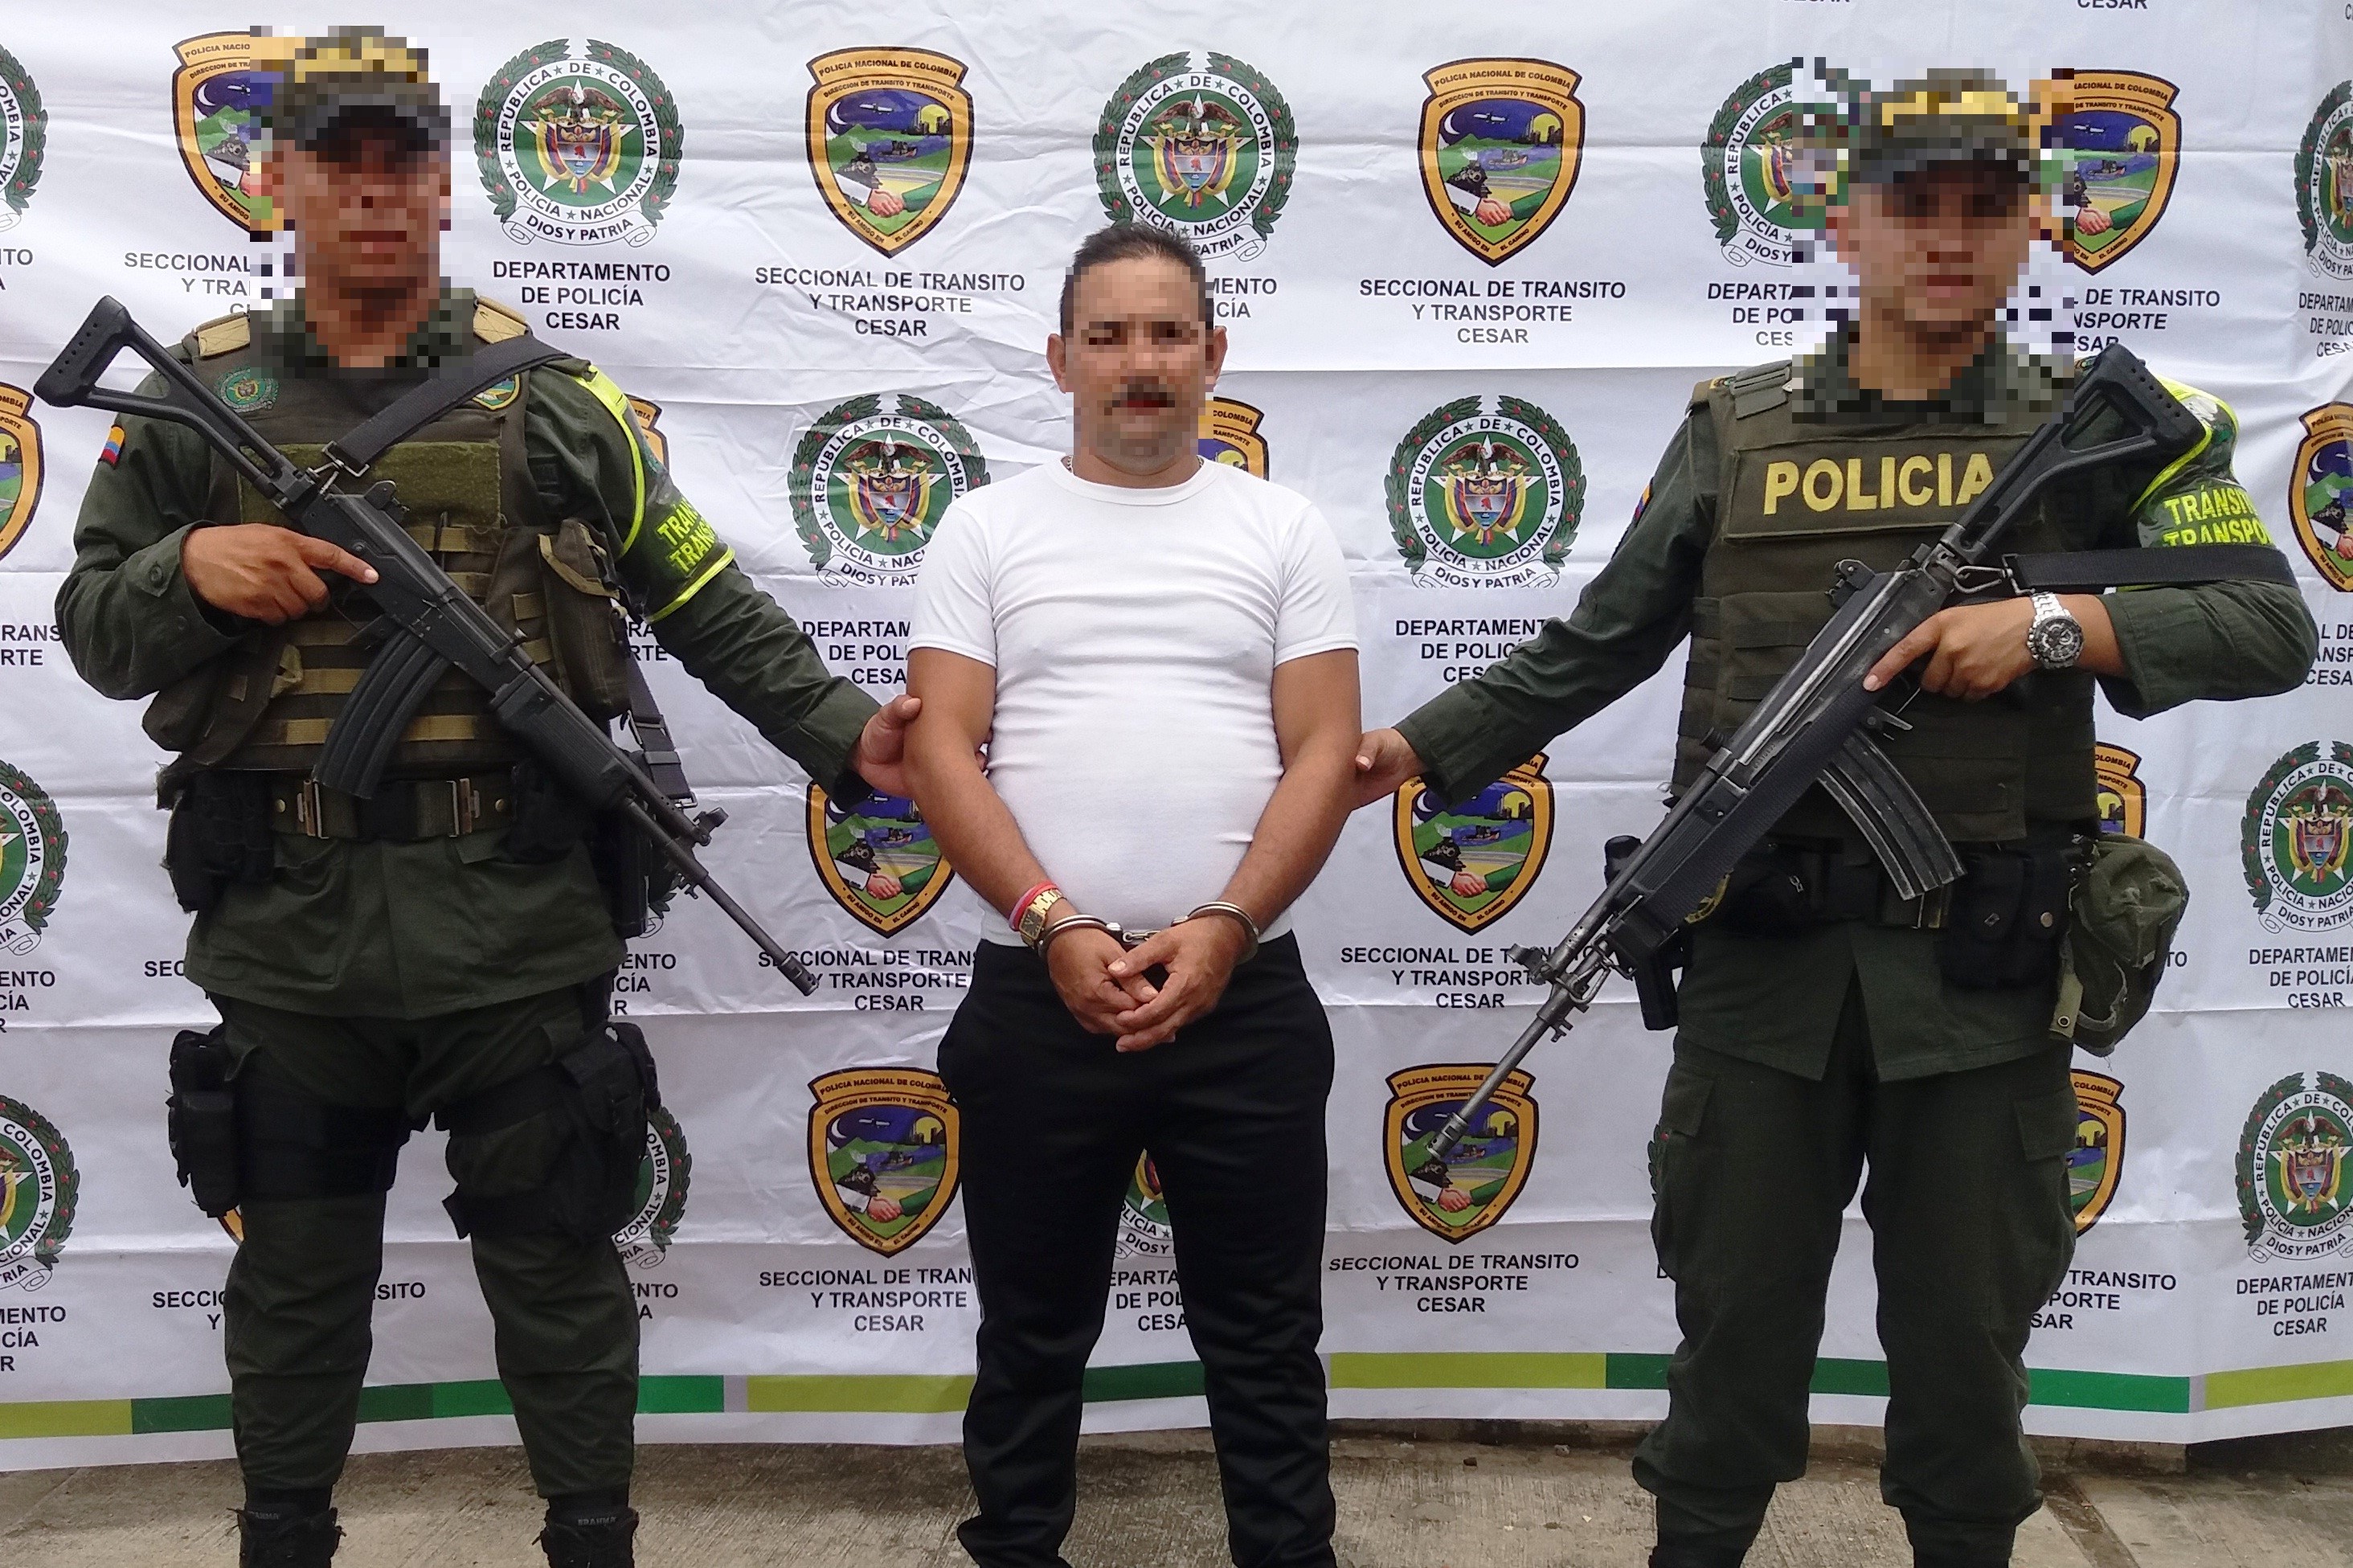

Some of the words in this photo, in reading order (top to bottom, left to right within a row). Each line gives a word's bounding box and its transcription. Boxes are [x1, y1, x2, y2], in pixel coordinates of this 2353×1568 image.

[185, 44, 221, 59] POLICIA
[819, 61, 853, 77] POLICIA
[855, 59, 898, 68] NACIONAL
[915, 61, 957, 80] COLOMBIA
[1434, 72, 1468, 87] POLICIA
[1470, 71, 1512, 79] NACIONAL
[1528, 72, 1570, 89] COLOMBIA
[2127, 84, 2168, 101] COLOMBIA
[570, 63, 591, 74] DE
[609, 73, 657, 157] COLOMBIA
[1191, 76, 1211, 87] DE
[1229, 86, 1271, 167] COLOMBIA
[581, 175, 651, 220] NACIONAL
[1194, 187, 1264, 235] NACIONAL
[581, 219, 633, 240] PATRIA
[494, 261, 669, 281] DEPARTAMENTO
[755, 268, 878, 287] SECCIONAL
[886, 272, 912, 288] DE
[919, 273, 1024, 291] TRANSITO
[182, 278, 195, 292] Y
[1361, 280, 1480, 297] SECCIONAL
[1488, 281, 1514, 297] DE
[1522, 281, 1625, 298] TRANSITO
[1708, 283, 1792, 300] DEPART
[522, 287, 550, 303] DE
[558, 285, 643, 305] POLICÍA
[809, 293, 821, 309] Y
[829, 295, 971, 312] TRANSPORTE
[2085, 289, 2113, 305] DE
[2120, 289, 2220, 306] TRANSITO
[2299, 293, 2353, 313] DEPARTAM
[546, 313, 620, 330] CESAR
[1412, 305, 1425, 319] Y
[1431, 305, 1571, 321] TRANSPORTE
[1733, 308, 1759, 323] DE
[2074, 312, 2167, 330] NSPORTE
[856, 319, 927, 336] CESAR
[2310, 317, 2325, 334] DE
[2328, 318, 2353, 336] POLIC
[1458, 328, 1528, 343] CESAR
[881, 417, 901, 428] DE
[1480, 419, 1501, 430] DE
[1517, 428, 1561, 507] COLOMBIA
[1764, 452, 1995, 516] POLICIA
[2163, 484, 2259, 526] TRÁNSIT
[2163, 518, 2275, 547] TRANSPO
[1486, 525, 1553, 571] NACIONAL
[1486, 567, 1537, 588] PATRIA
[803, 621, 911, 637] DEPARTAM
[1396, 619, 1547, 637] DEPARTAMENT
[829, 645, 856, 660] DE
[1422, 644, 1448, 658] DE
[1456, 640, 1519, 660] POLIC
[852, 668, 906, 685] CESA
[2318, 763, 2335, 774] DE
[884, 950, 910, 964] DE
[917, 951, 976, 967] TRAN
[1341, 948, 1459, 963] SECCIONAL
[1467, 948, 1492, 963] DE
[2249, 947, 2353, 964] DEPARTAME
[829, 972, 967, 988] TRANSPORTE
[1392, 970, 1404, 985] Y
[1410, 970, 1548, 986] TRANSPORT
[2270, 972, 2291, 986] DE
[855, 995, 923, 1011] CESAR
[1436, 993, 1505, 1009] CESAR
[2288, 993, 2345, 1009] CESAR
[820, 1081, 852, 1095] POLICIA
[2304, 1093, 2320, 1104] DE
[5, 1124, 53, 1202] COLOMBIA
[2308, 1206, 2353, 1238] NACION
[2306, 1233, 2347, 1255] PATRIA
[1329, 1256, 1442, 1271] SECCIONAL
[1449, 1255, 1474, 1269] DE
[1481, 1255, 1578, 1269] TRANSITO
[759, 1270, 877, 1286] SECCIONAL
[884, 1269, 910, 1283] DE
[1377, 1276, 1389, 1290] Y
[1394, 1275, 1528, 1290] TRANSPORTE
[2069, 1270, 2175, 1290] TRANSITO
[2236, 1272, 2353, 1294] DEPARTAMENT
[153, 1291, 226, 1308] SECCIO
[811, 1292, 824, 1308] Y
[829, 1292, 966, 1308] TRANSPORTE
[1116, 1293, 1141, 1309] DE
[1418, 1297, 1484, 1312] CESAR
[2257, 1300, 2278, 1315] DE
[2284, 1294, 2344, 1313] POLICÍA
[207, 1314, 220, 1329] Y
[855, 1316, 923, 1331] CESAR
[1138, 1313, 1185, 1332] CESA
[2274, 1318, 2326, 1336] CESAR
